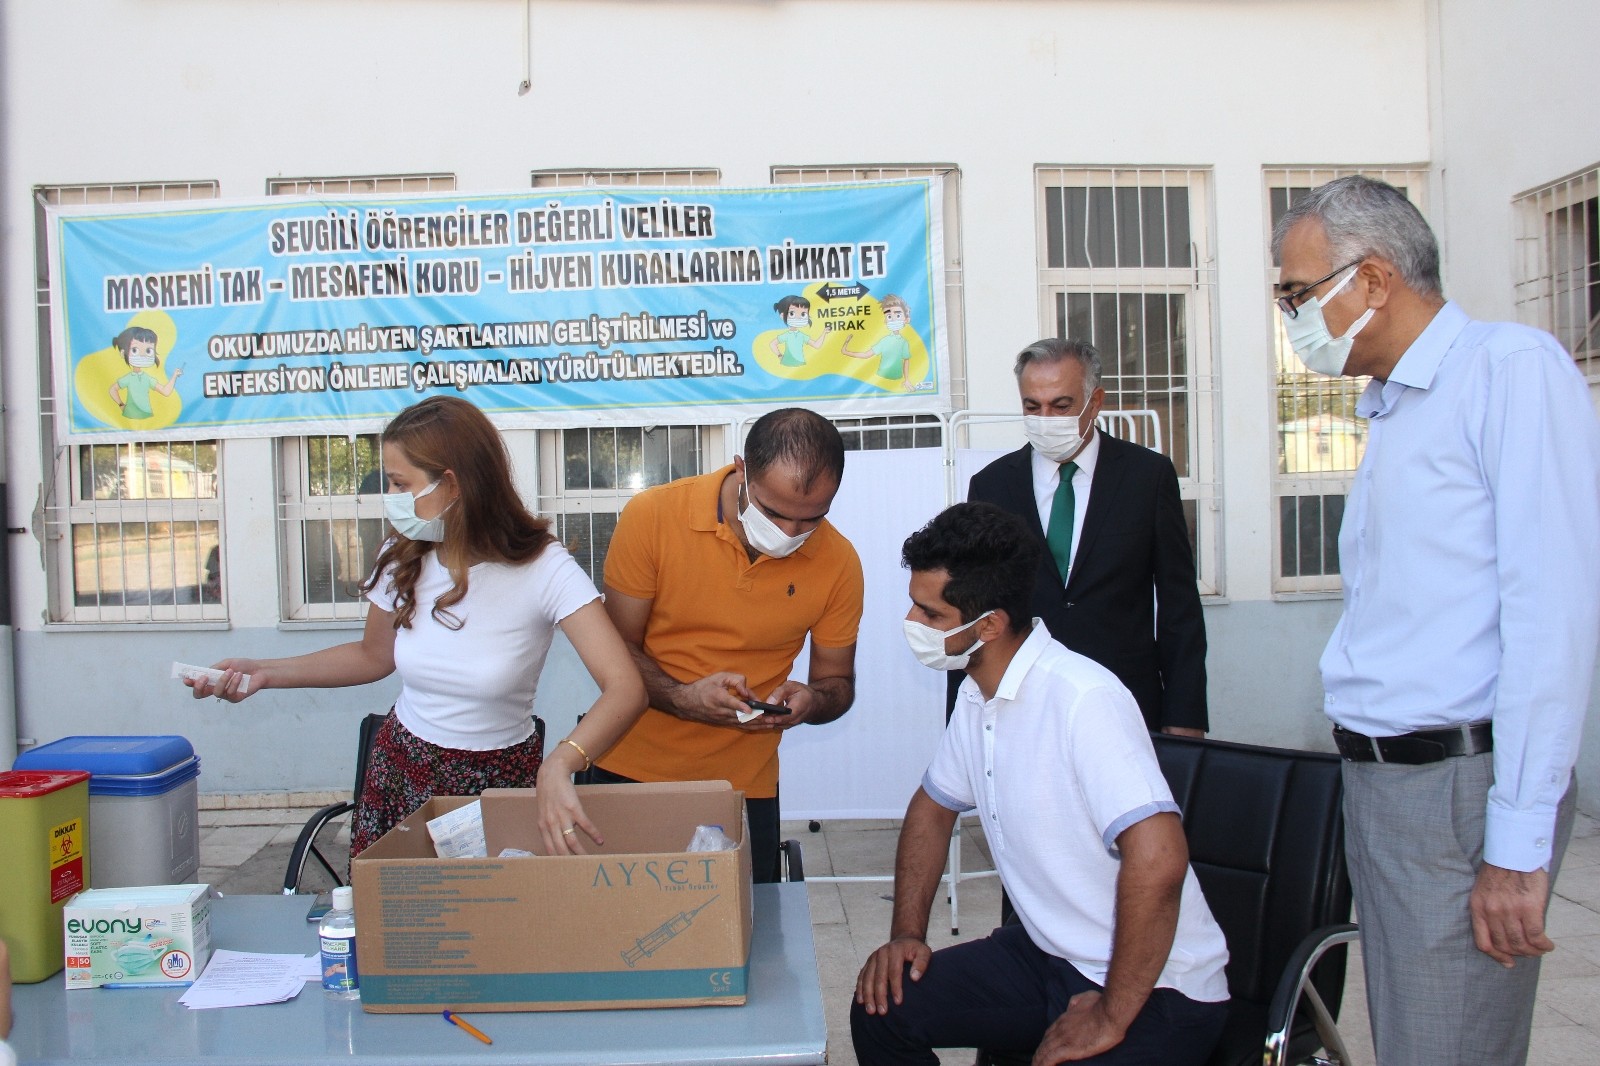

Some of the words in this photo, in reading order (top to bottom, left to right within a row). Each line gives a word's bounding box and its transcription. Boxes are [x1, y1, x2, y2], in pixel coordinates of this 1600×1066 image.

[271, 211, 359, 254] SEVGİLİ
[366, 206, 508, 250] ÖĞRENCİLER
[517, 202, 612, 244] DEĞERLİ
[621, 200, 713, 239] VELİLER
[106, 267, 211, 310] MASKENİ
[220, 270, 261, 302] TAK
[292, 258, 408, 298] MESAFENİ
[416, 261, 479, 294] KORU
[509, 250, 592, 289] HİJYEN
[601, 246, 760, 286] KURALLARINA
[770, 242, 852, 281] DİKKAT
[860, 245, 886, 276] ET
[825, 288, 836, 297] 1,5
[838, 287, 860, 296] METRE
[817, 305, 871, 318] MESAFE
[824, 320, 865, 331] BIRAK
[209, 329, 341, 358] OKULUMUZDA
[347, 326, 415, 353] HİJYEN
[421, 324, 548, 356] ŞARTLARININ
[554, 312, 707, 347] GELİŞTİRİLMESİ
[709, 322, 734, 338] ve
[205, 366, 324, 396] ENFEKSİYON
[330, 366, 407, 391] ÖNLEME
[413, 361, 540, 390] ÇALIŞMALARI
[545, 350, 742, 380] YÜRÜTÜLMEKTEDİR.
[592, 859, 716, 890] AYSET
[67, 918, 142, 934] evony
